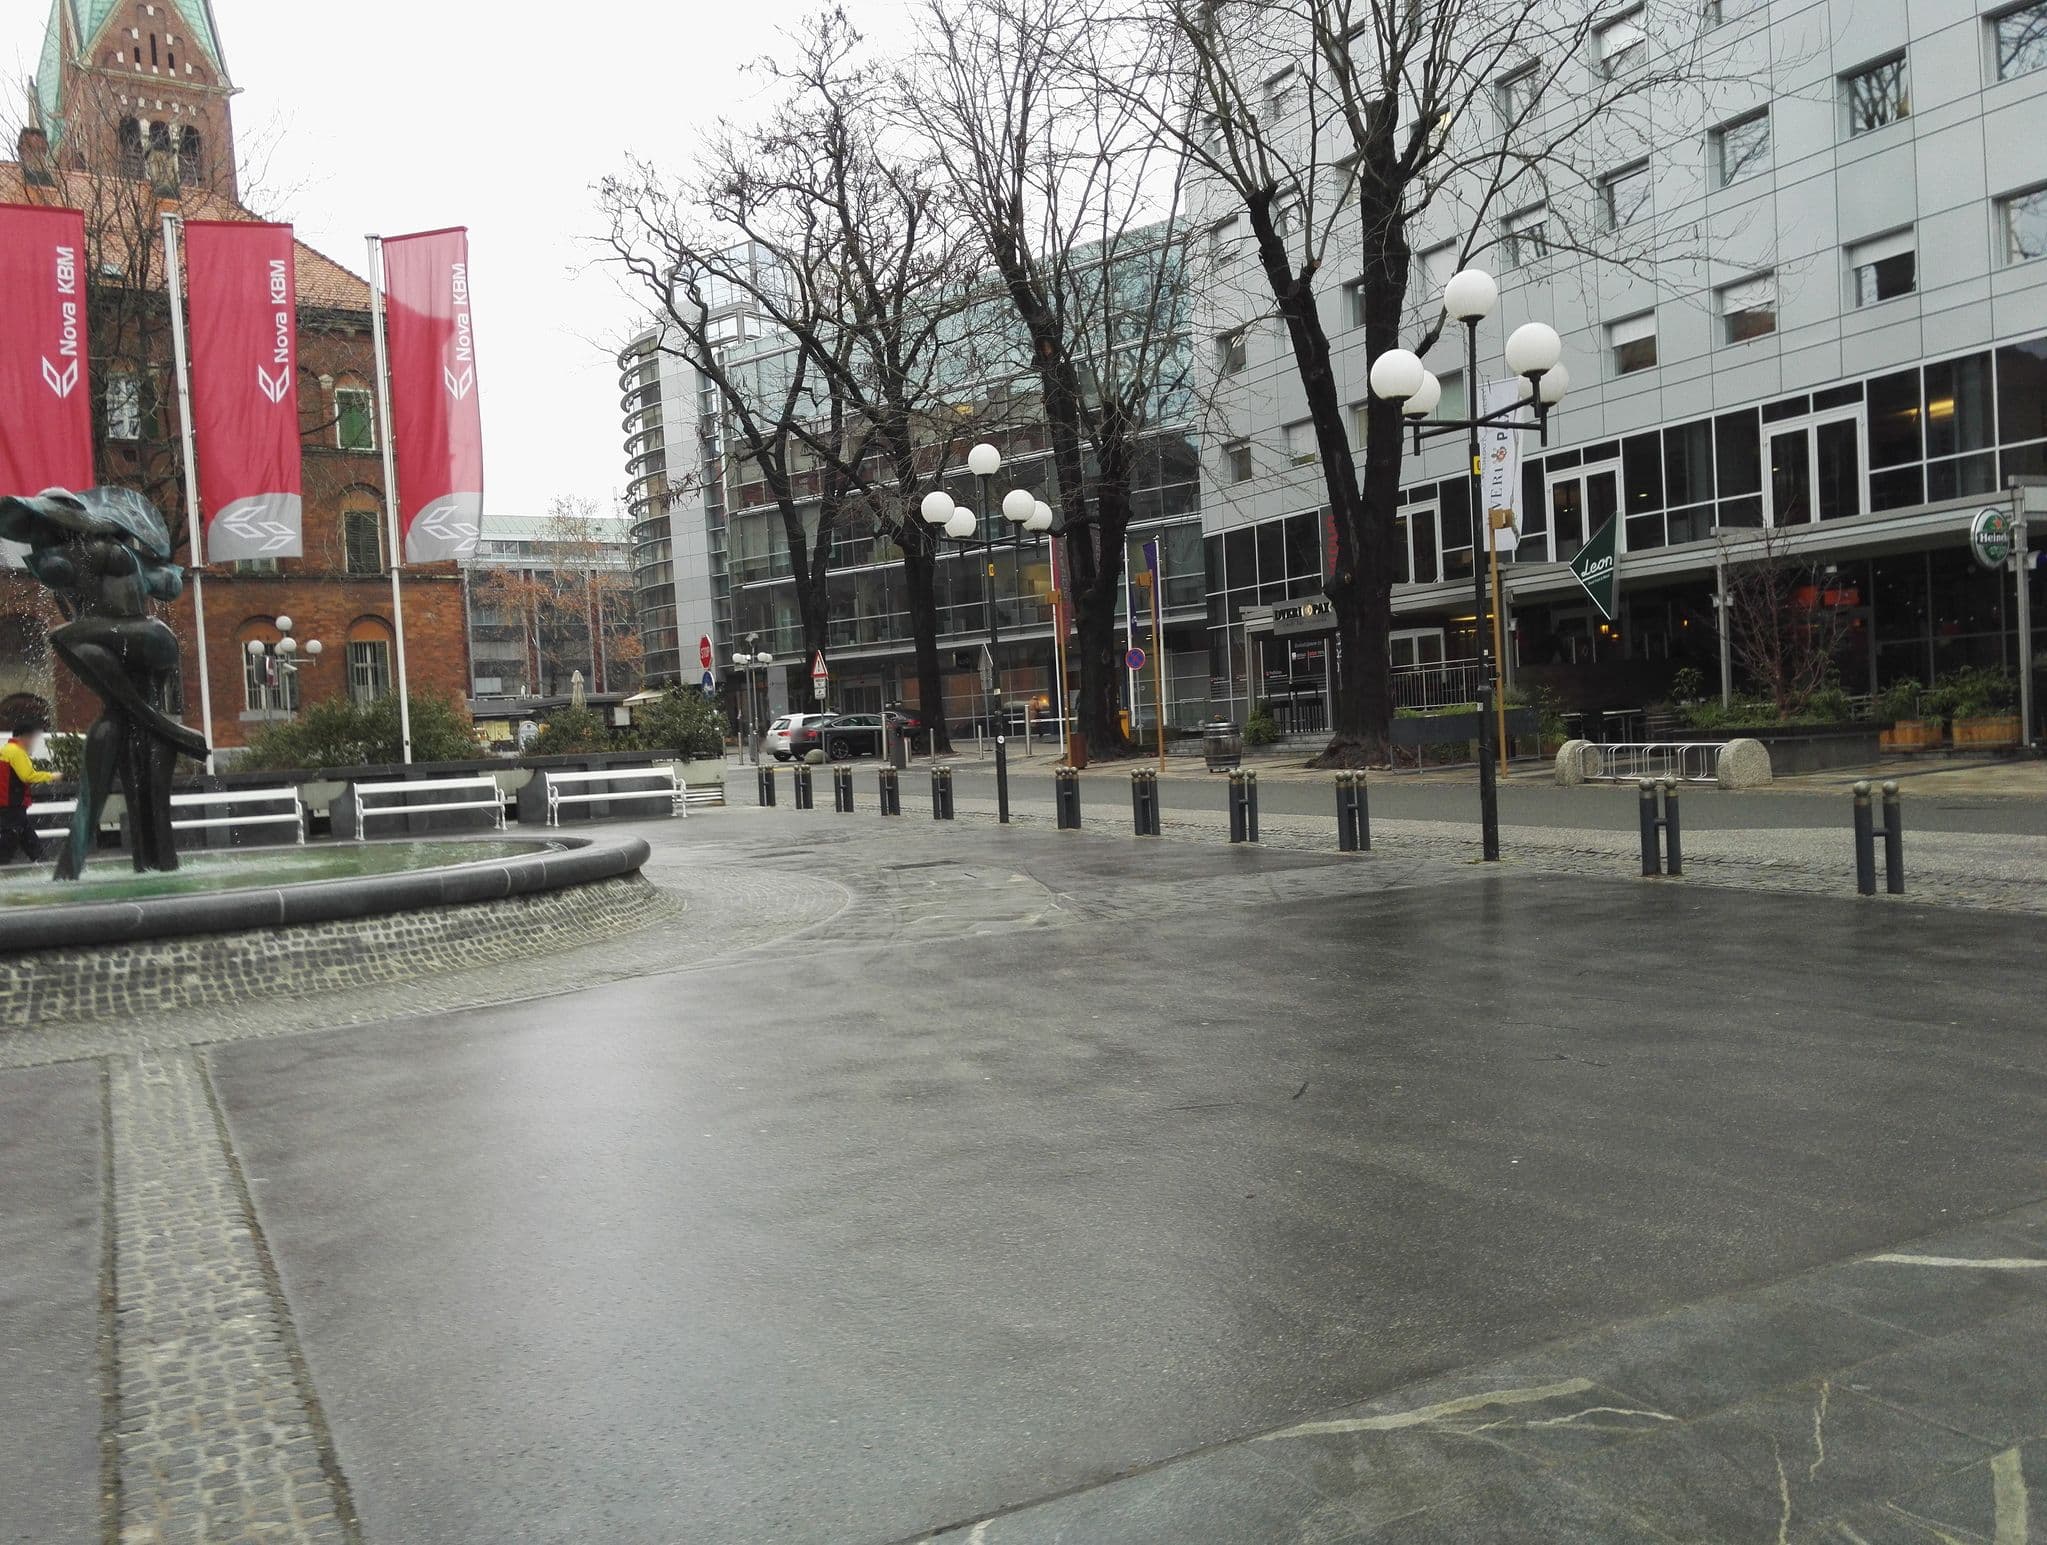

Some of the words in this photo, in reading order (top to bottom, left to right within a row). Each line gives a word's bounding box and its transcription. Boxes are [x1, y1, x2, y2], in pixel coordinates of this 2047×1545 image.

[57, 247, 75, 295] KBM
[269, 259, 287, 305] KBM
[451, 262, 467, 305] KBM
[59, 302, 77, 356] Nova
[274, 312, 290, 363] Nova
[455, 313, 472, 361] Nova
[1580, 555, 1613, 577] Leon
[700, 646, 710, 658] STOP
